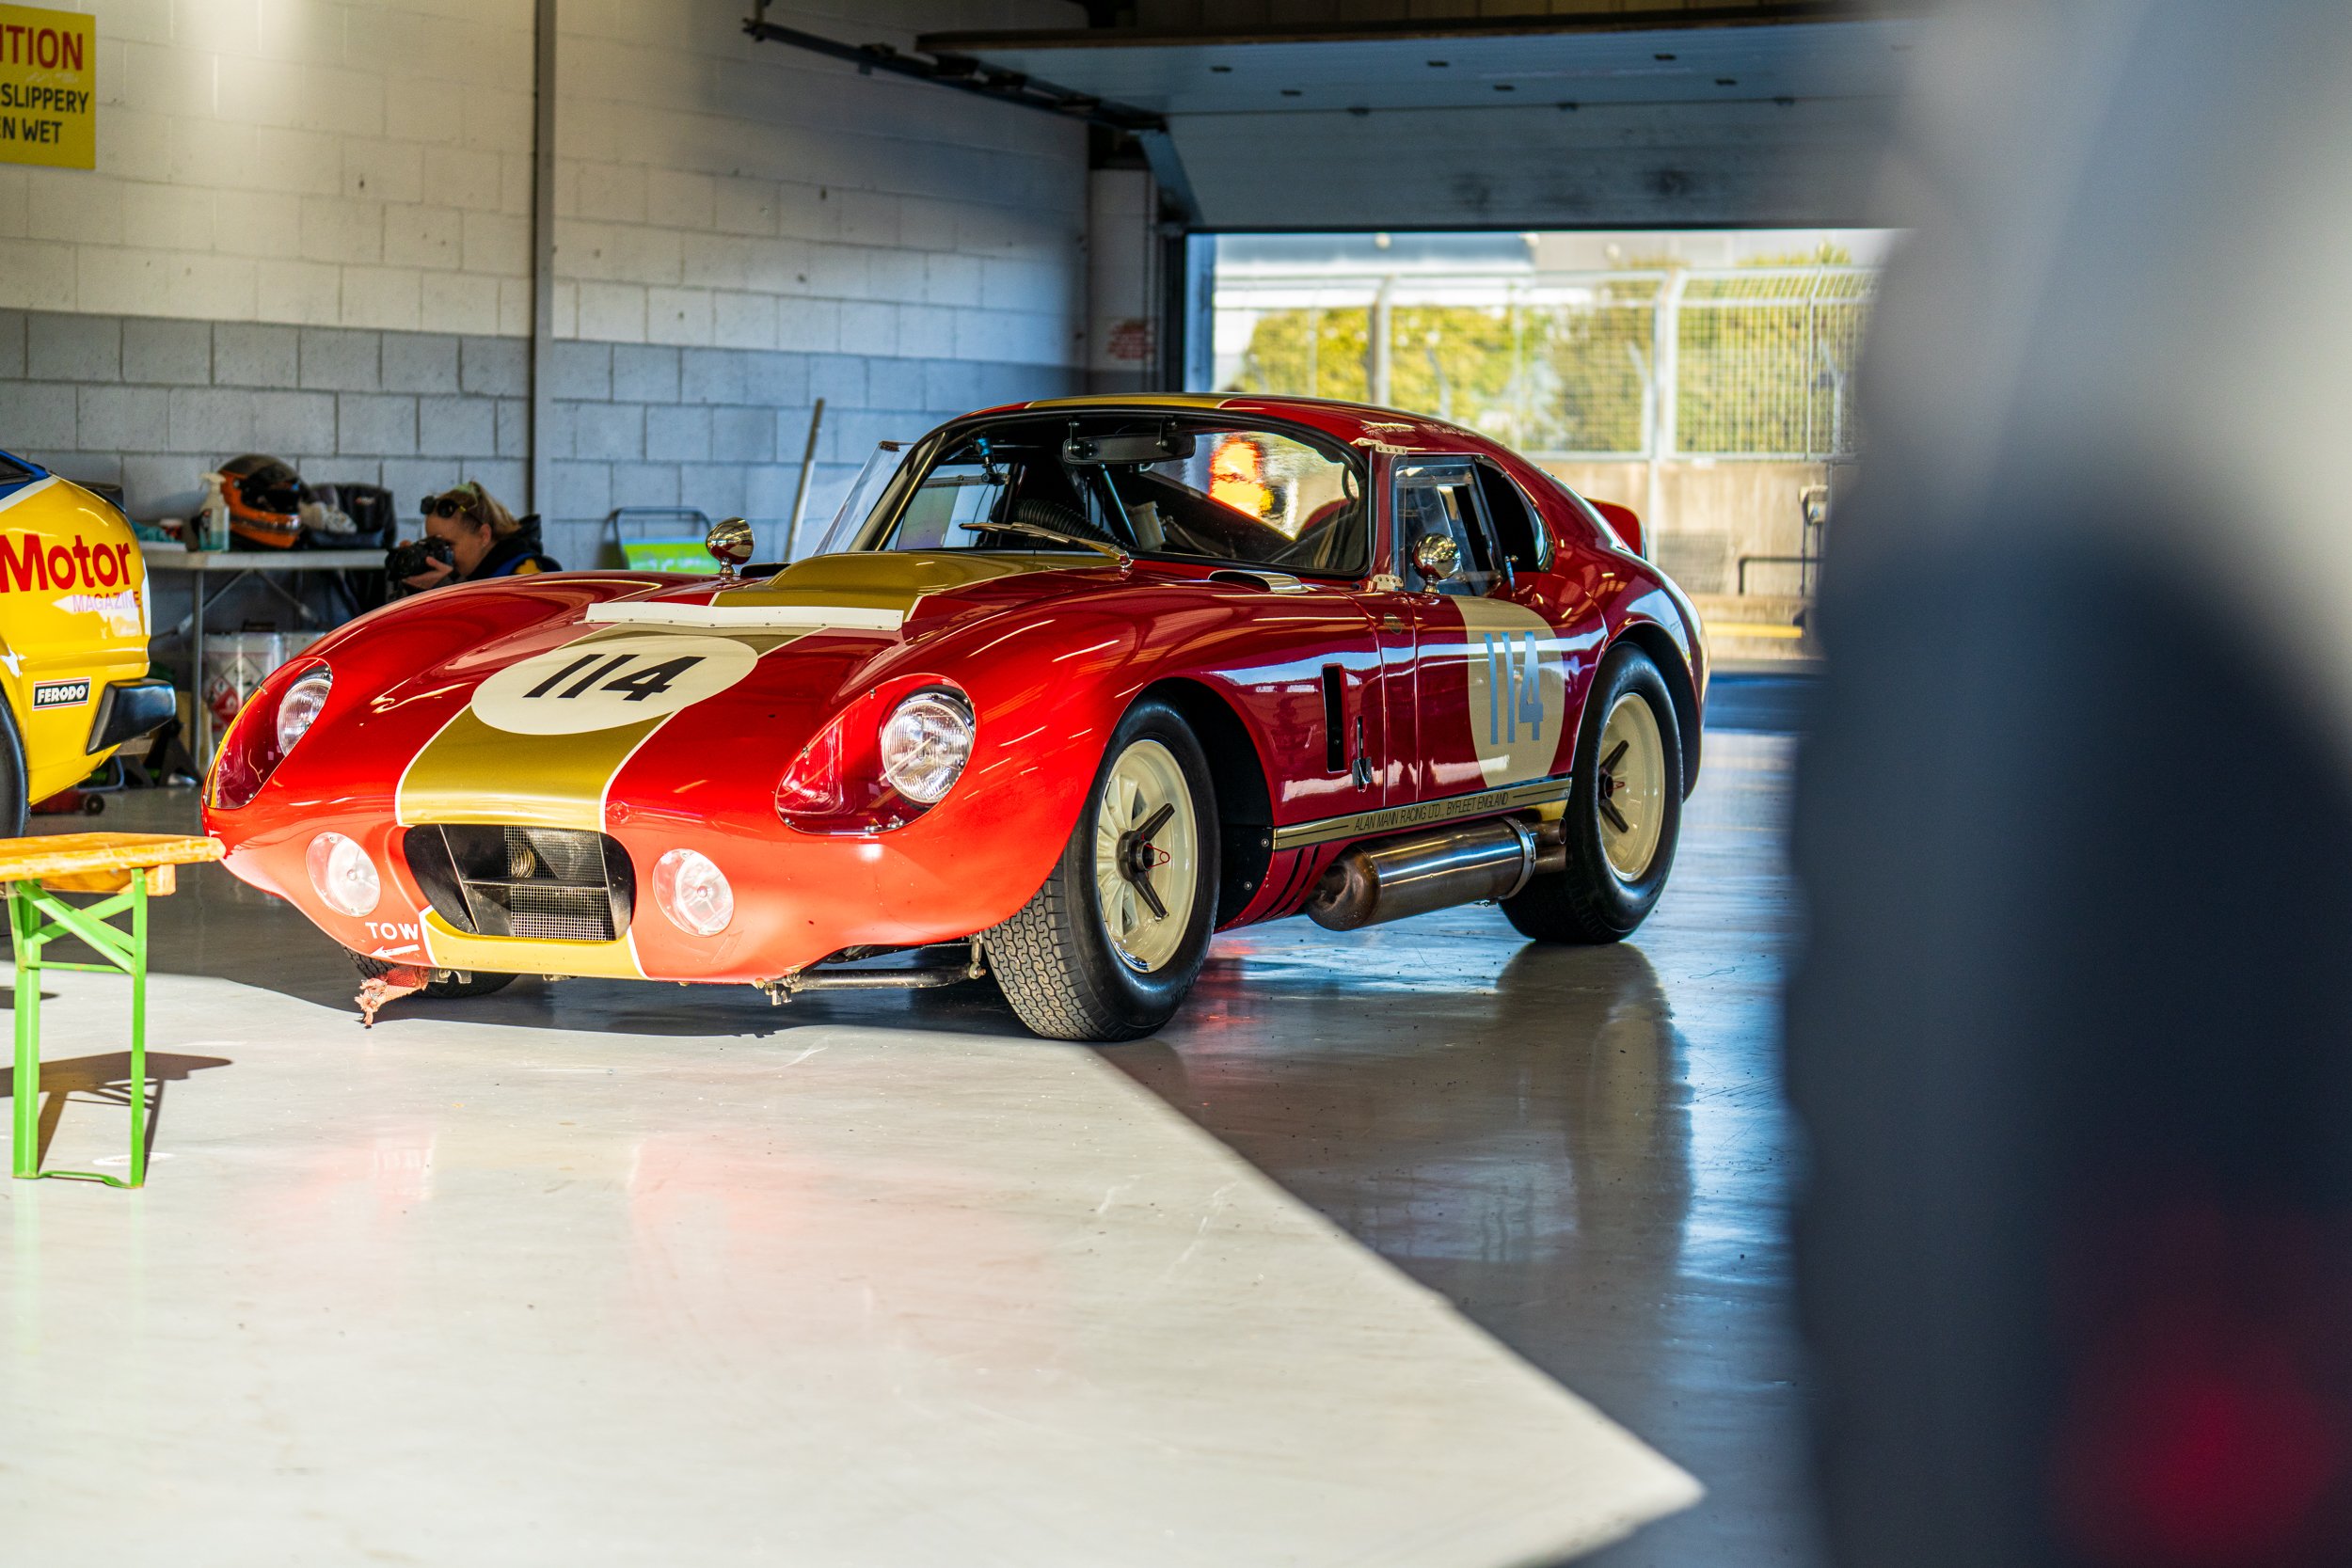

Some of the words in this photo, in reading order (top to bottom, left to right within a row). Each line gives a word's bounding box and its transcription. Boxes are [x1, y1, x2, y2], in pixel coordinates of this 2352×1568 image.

[1, 83, 89, 114] SLIPPERY
[0, 116, 15, 139] N
[22, 118, 63, 144] WET
[0, 533, 131, 593] Motor
[72, 592, 141, 612] MAGAZINE
[522, 654, 707, 702] 114
[1484, 631, 1544, 745] 114
[37, 684, 87, 704] FERODO
[1354, 816, 1376, 832] ALAN
[1376, 812, 1399, 829] MANN
[1400, 806, 1427, 823] RACING
[1446, 799, 1476, 816] BYFLEET
[1476, 792, 1509, 811] ENGLAND
[364, 922, 419, 941] TOW
